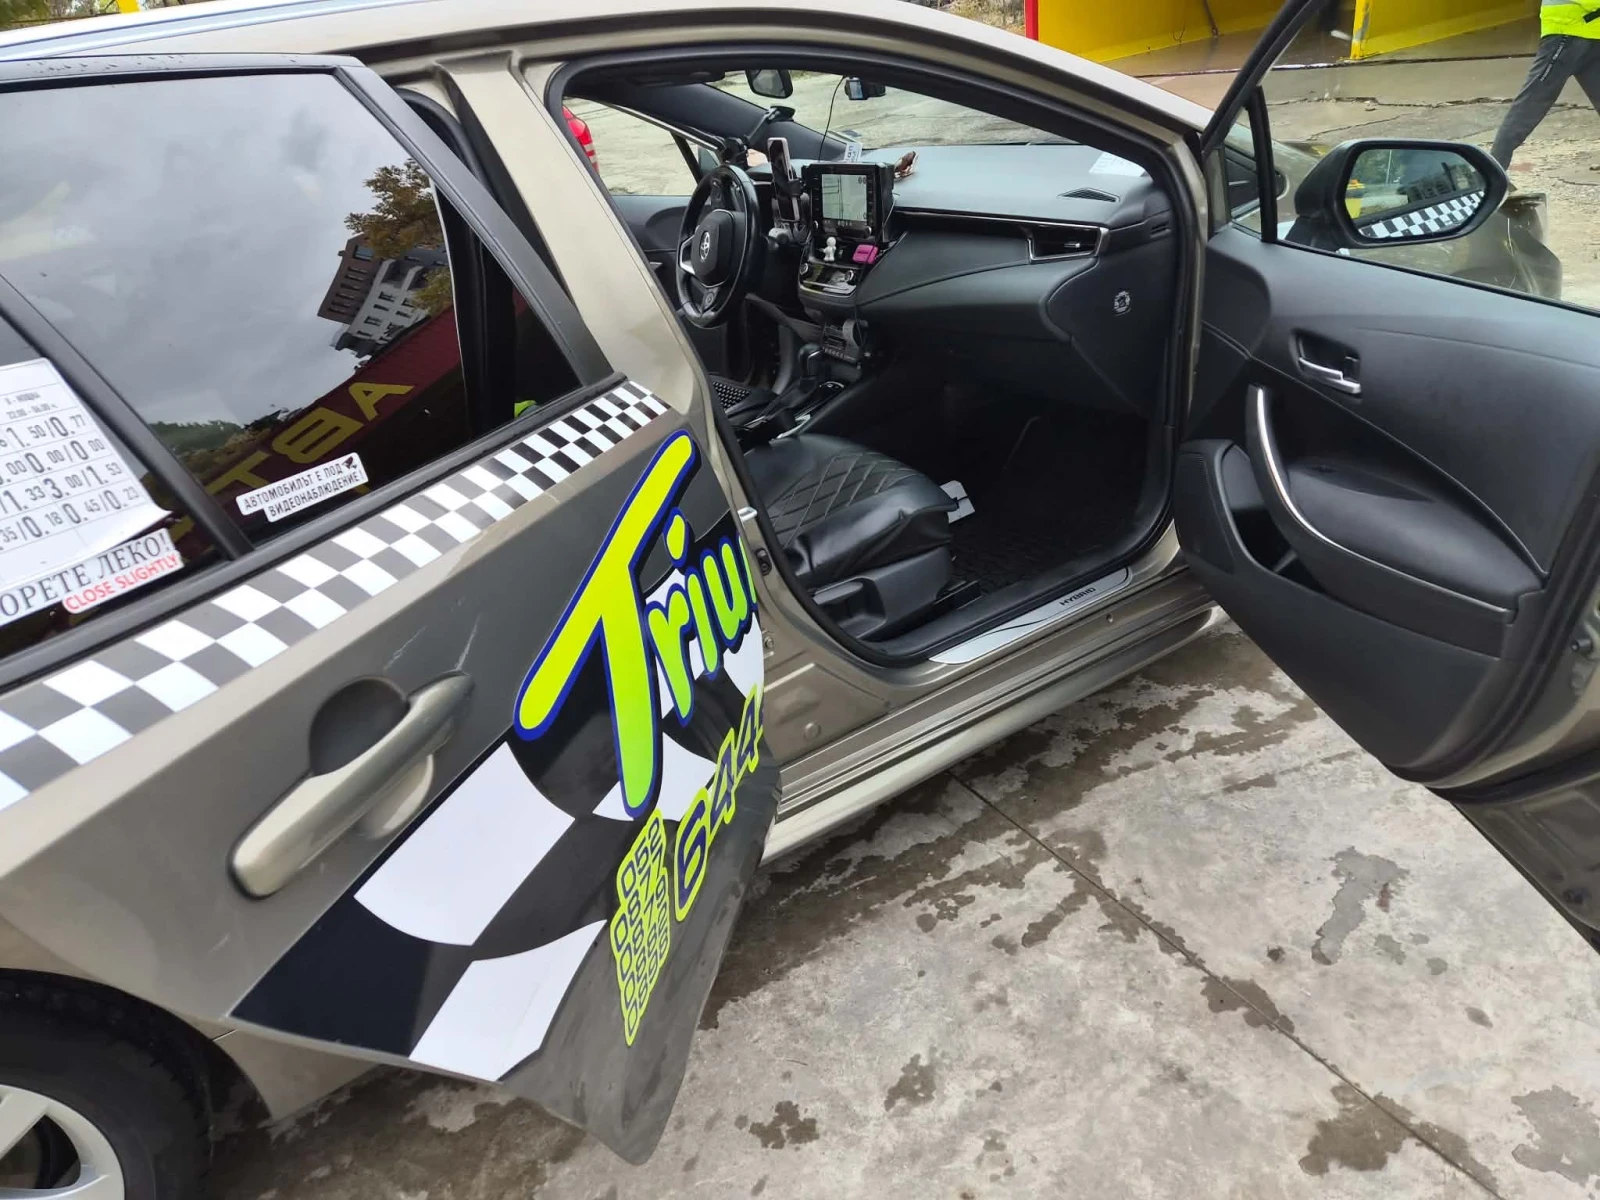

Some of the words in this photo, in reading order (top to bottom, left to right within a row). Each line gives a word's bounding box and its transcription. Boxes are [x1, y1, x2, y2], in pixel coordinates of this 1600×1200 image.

[244, 475, 315, 510] АВТОМОБИЛЪТ
[315, 471, 323, 481] Е
[323, 463, 343, 479] ПОД
[64, 583, 115, 612] CLOSE
[115, 554, 180, 588] SLIGHTLY
[98, 532, 170, 579] ЛЕКО!
[514, 429, 757, 818] Triu
[1059, 587, 1096, 606] HYBRID
[620, 816, 662, 899] 052
[613, 843, 663, 952] 0877
[619, 874, 667, 982] 0879
